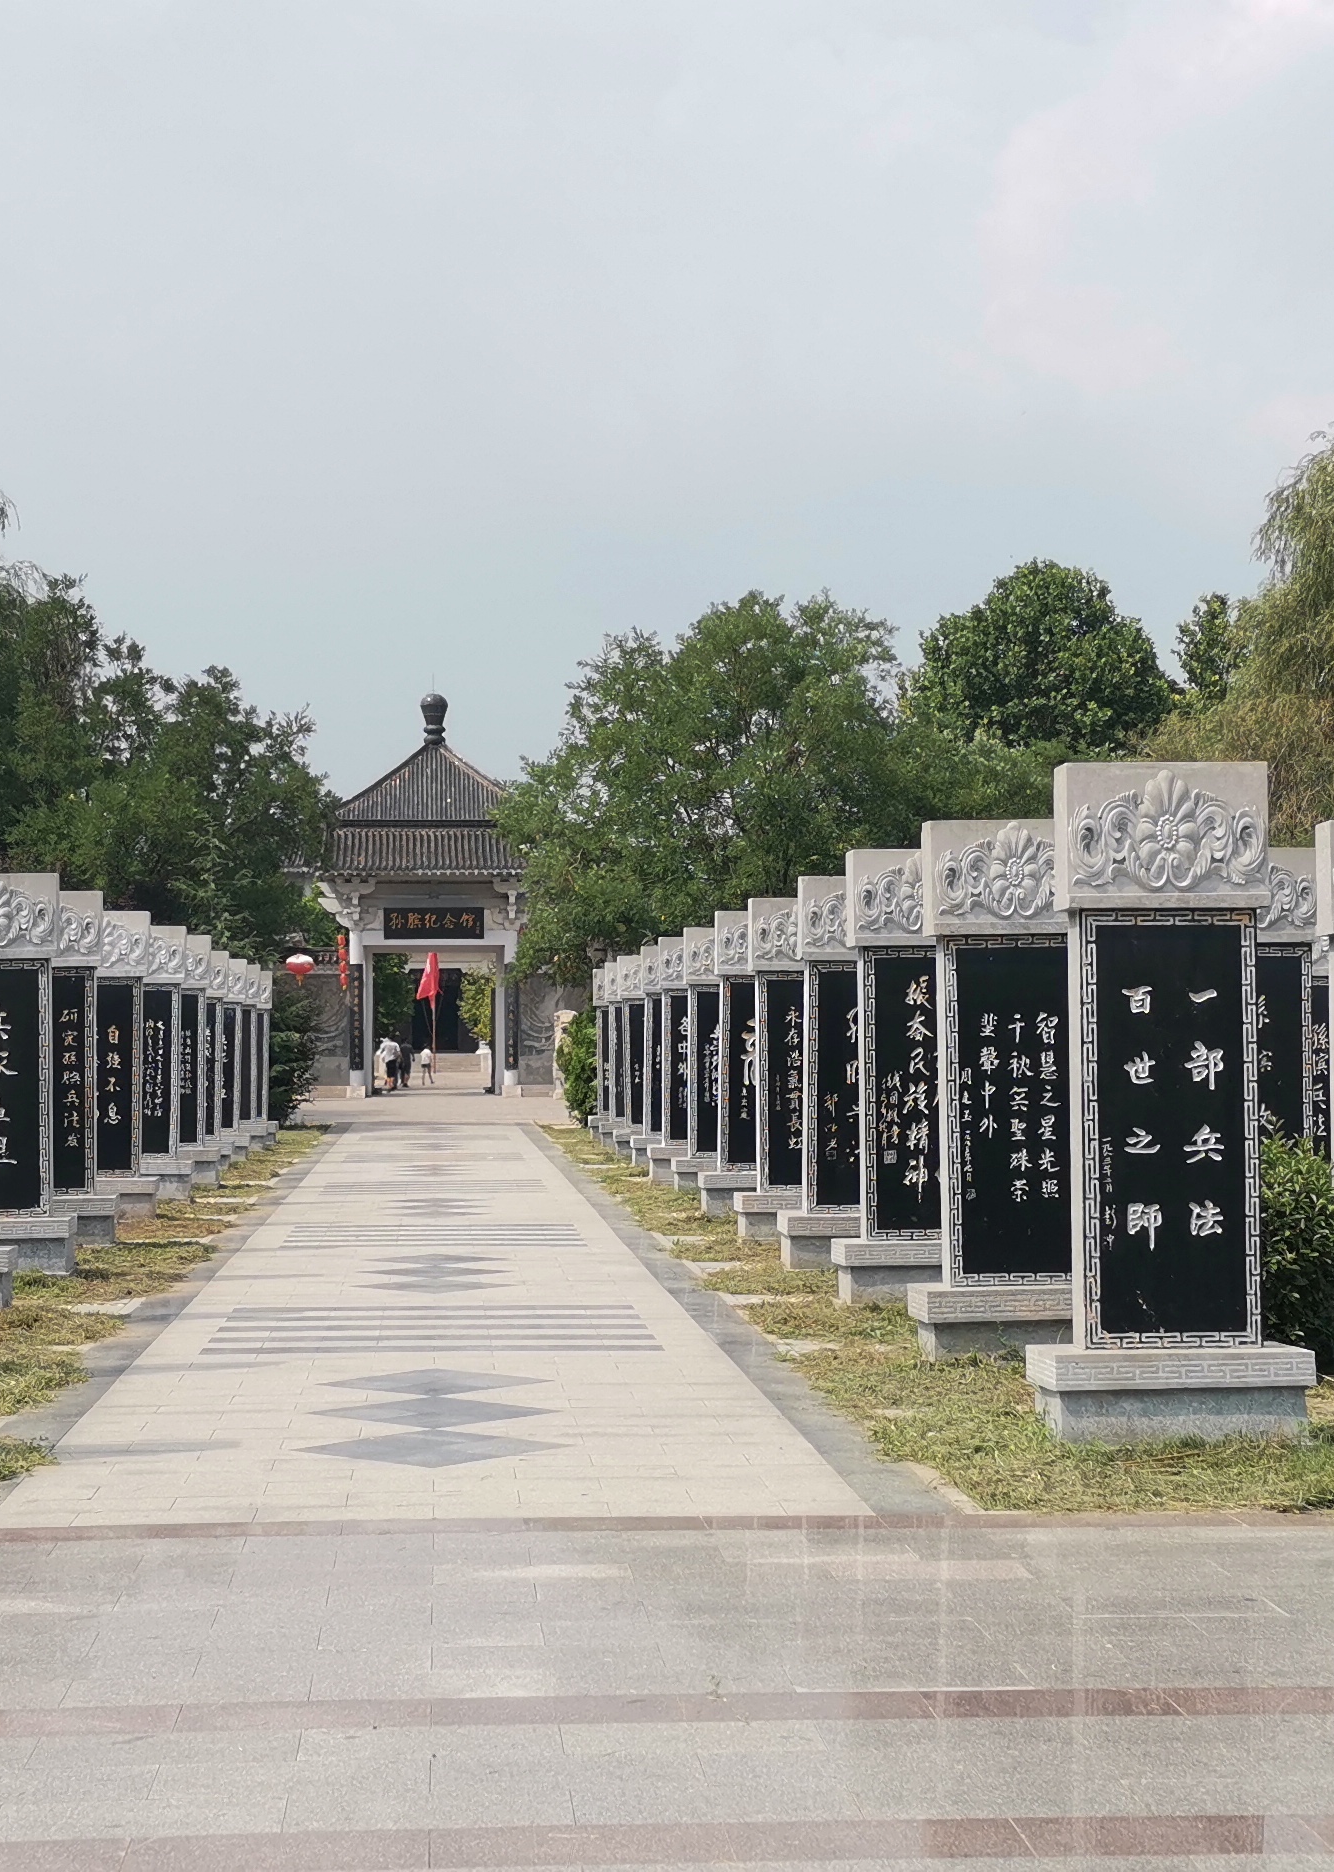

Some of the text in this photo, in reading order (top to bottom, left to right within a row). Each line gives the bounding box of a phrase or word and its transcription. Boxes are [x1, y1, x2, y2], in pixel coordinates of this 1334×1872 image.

[389, 913, 474, 929] 孙膑纪念馆
[1183, 989, 1224, 1236] 一部兵法
